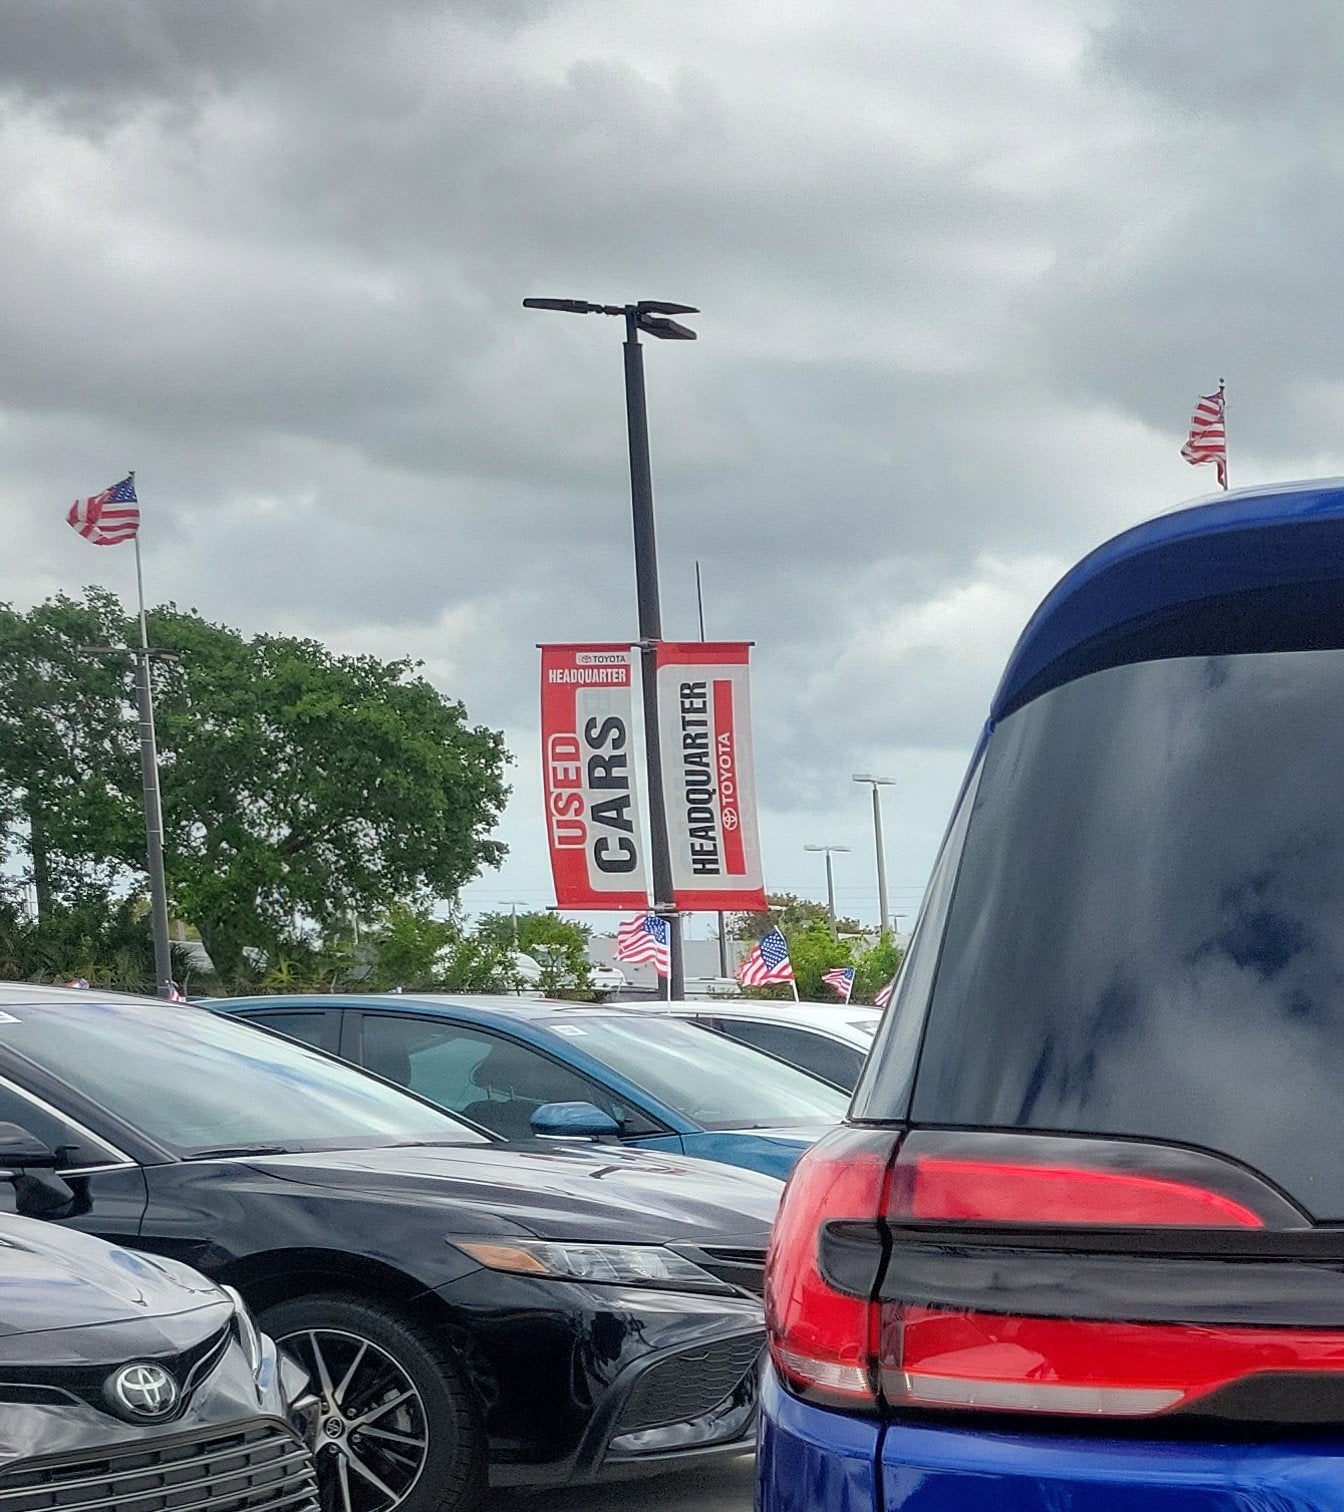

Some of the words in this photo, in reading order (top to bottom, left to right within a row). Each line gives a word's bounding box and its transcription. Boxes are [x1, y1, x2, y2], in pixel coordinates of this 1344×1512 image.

[548, 668, 626, 684] HEADQUARTER
[593, 655, 626, 663] TOYOTA
[547, 732, 588, 850] USED
[584, 715, 637, 874] CARS
[679, 681, 722, 875] HEADQUARTER
[717, 732, 735, 804] TOYOTA
